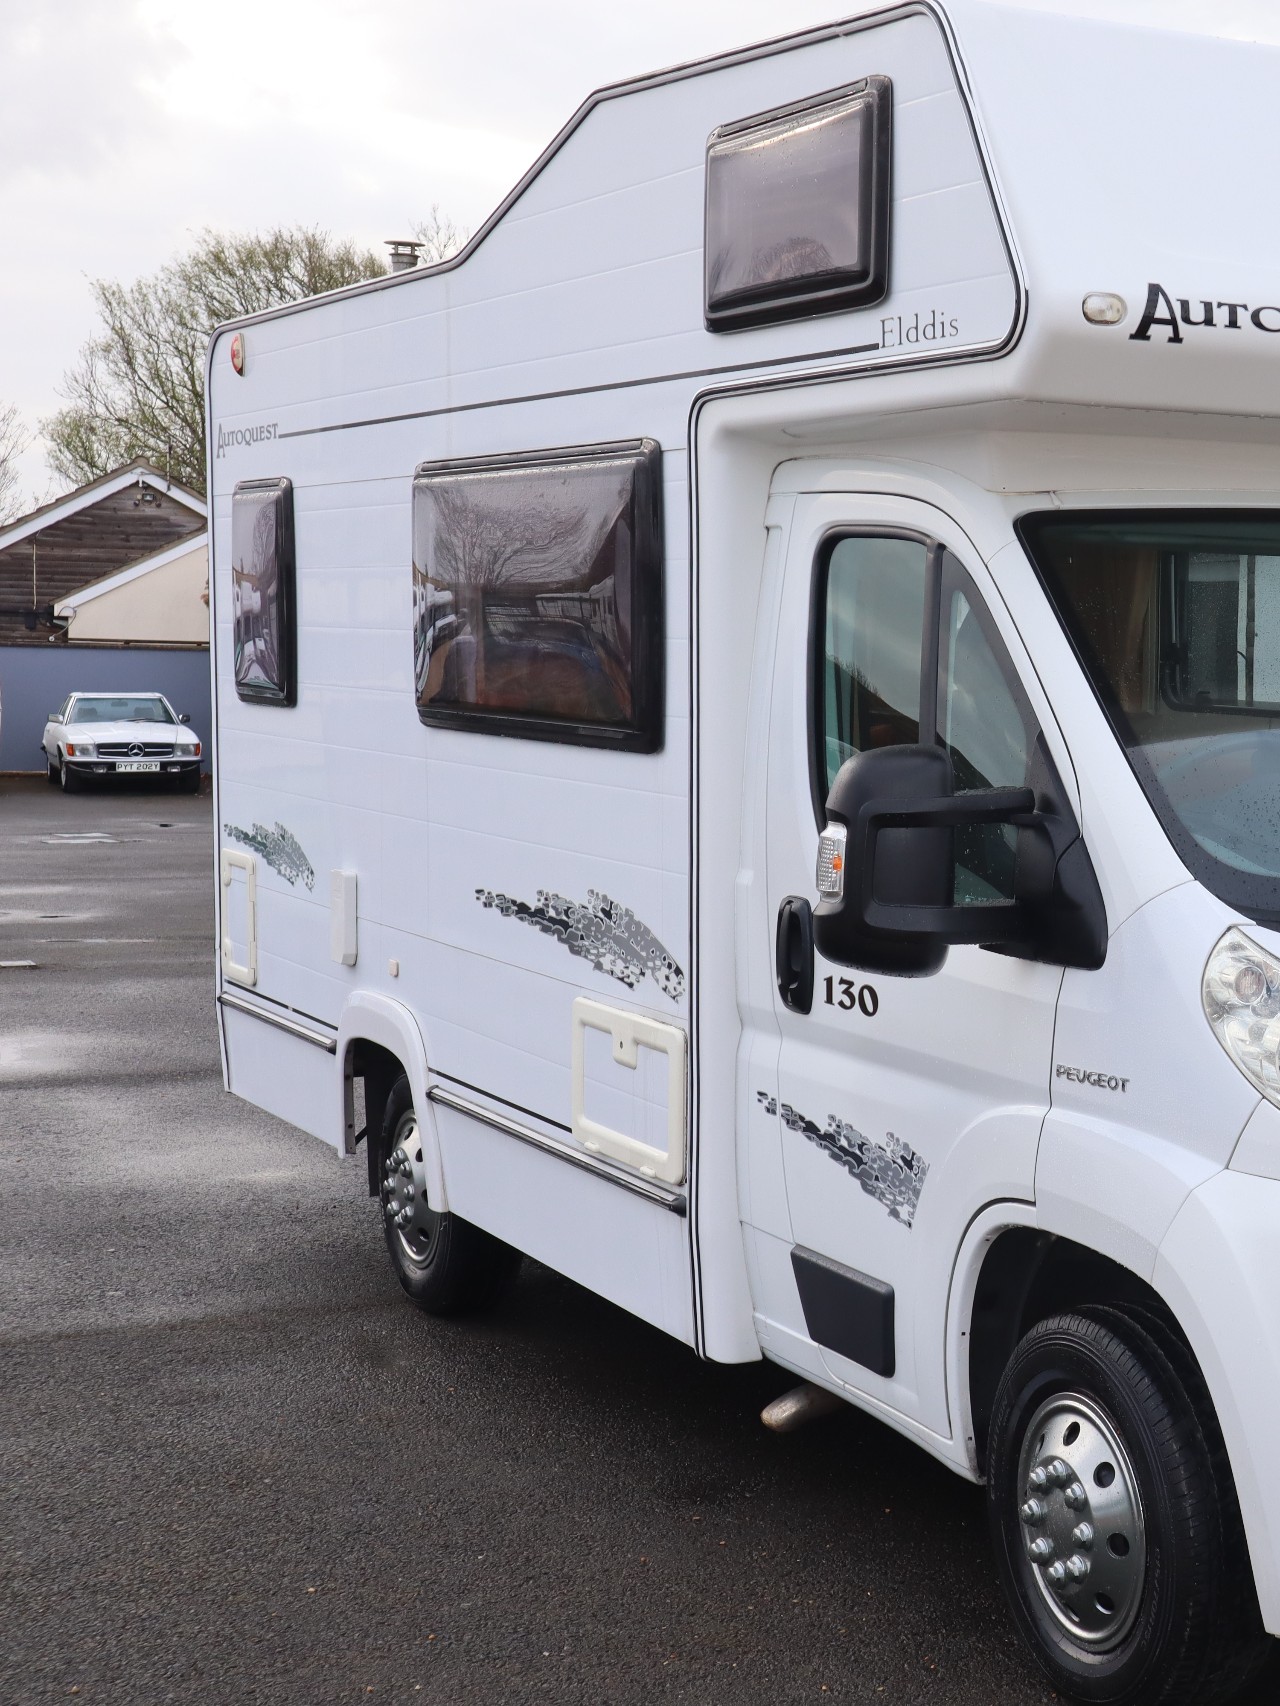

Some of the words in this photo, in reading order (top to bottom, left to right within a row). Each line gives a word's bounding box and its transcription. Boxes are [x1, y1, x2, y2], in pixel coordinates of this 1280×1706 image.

[880, 309, 959, 348] Elddis
[216, 423, 279, 459] AUTOQUEST
[823, 974, 879, 1017] 130
[1056, 1064, 1130, 1093] PEUGEOT
